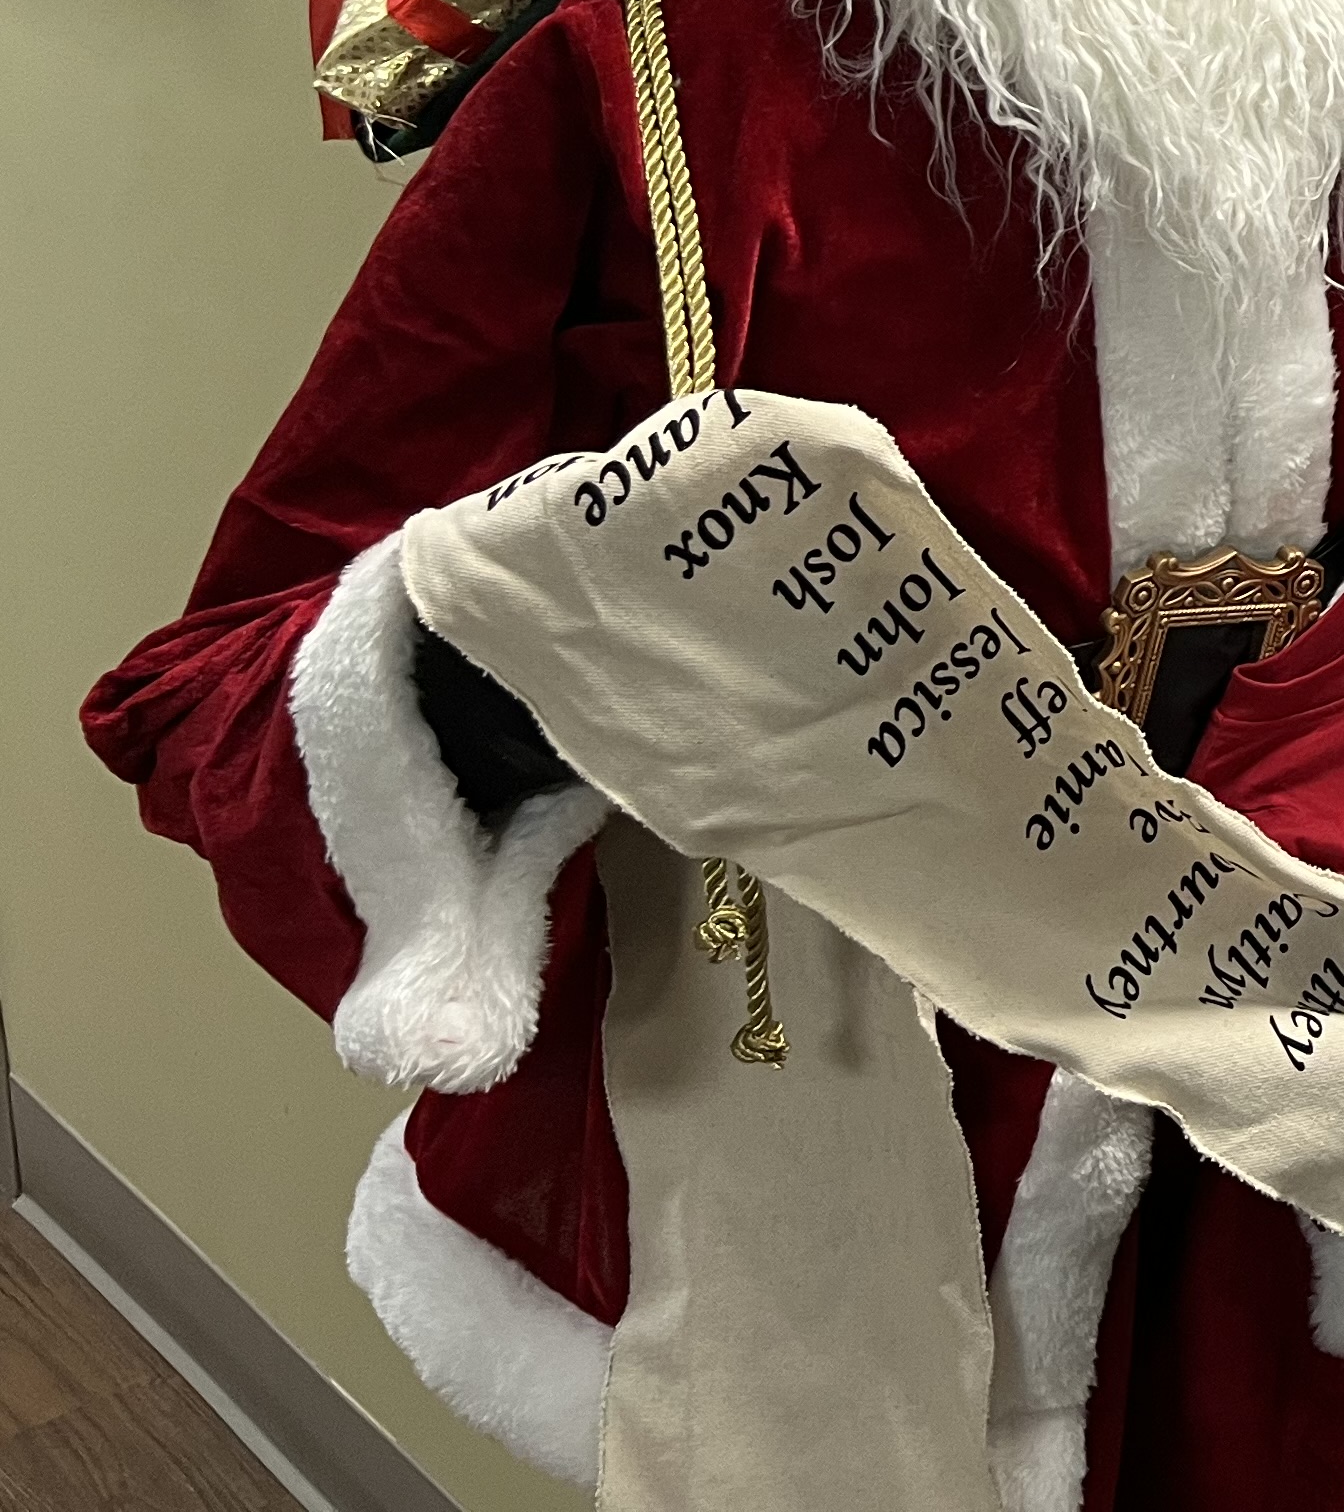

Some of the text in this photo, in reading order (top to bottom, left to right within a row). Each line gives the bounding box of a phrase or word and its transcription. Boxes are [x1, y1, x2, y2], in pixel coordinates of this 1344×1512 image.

[575, 389, 752, 527] Lance
[664, 440, 823, 580] Knox
[772, 491, 896, 614] Josh
[837, 548, 967, 677] John
[867, 607, 1032, 768] Jessica
